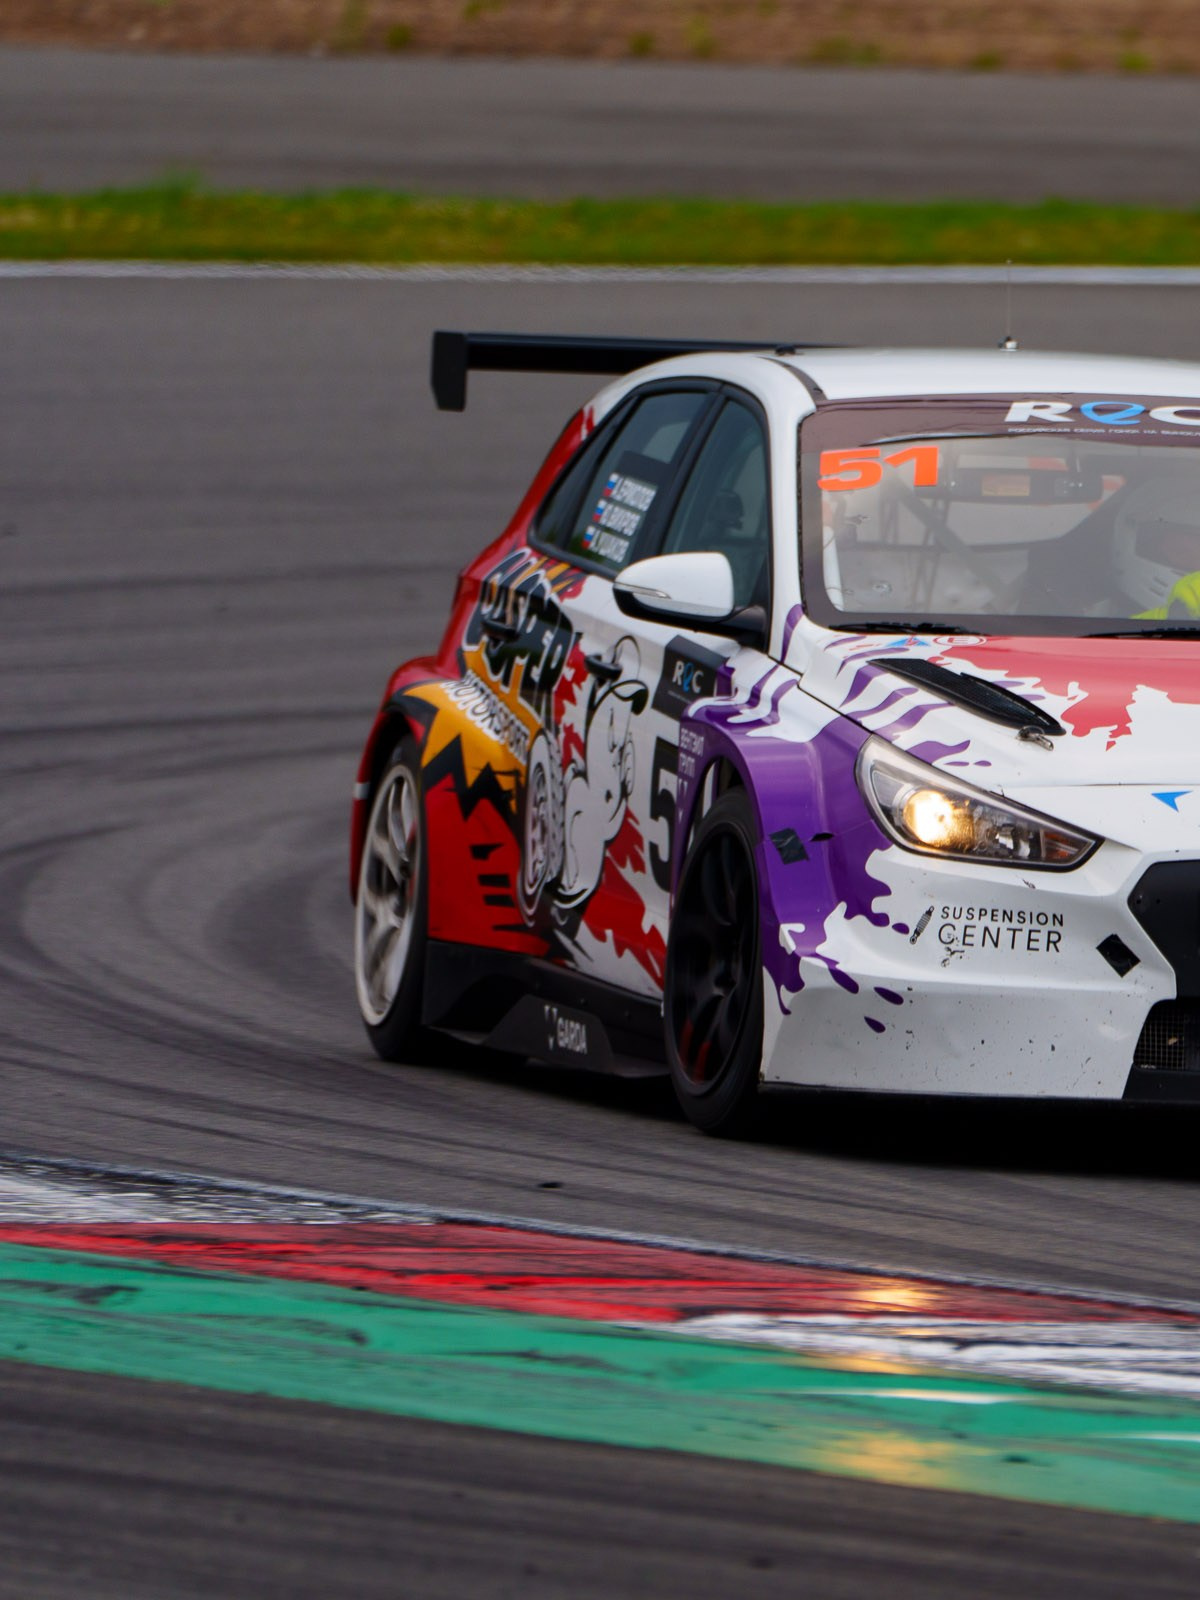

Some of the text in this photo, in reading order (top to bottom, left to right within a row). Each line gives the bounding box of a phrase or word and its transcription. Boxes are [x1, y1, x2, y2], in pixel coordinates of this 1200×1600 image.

[817, 446, 938, 492] 51
[940, 906, 1064, 927] SUSPENSION
[937, 923, 1062, 953] CENTER
